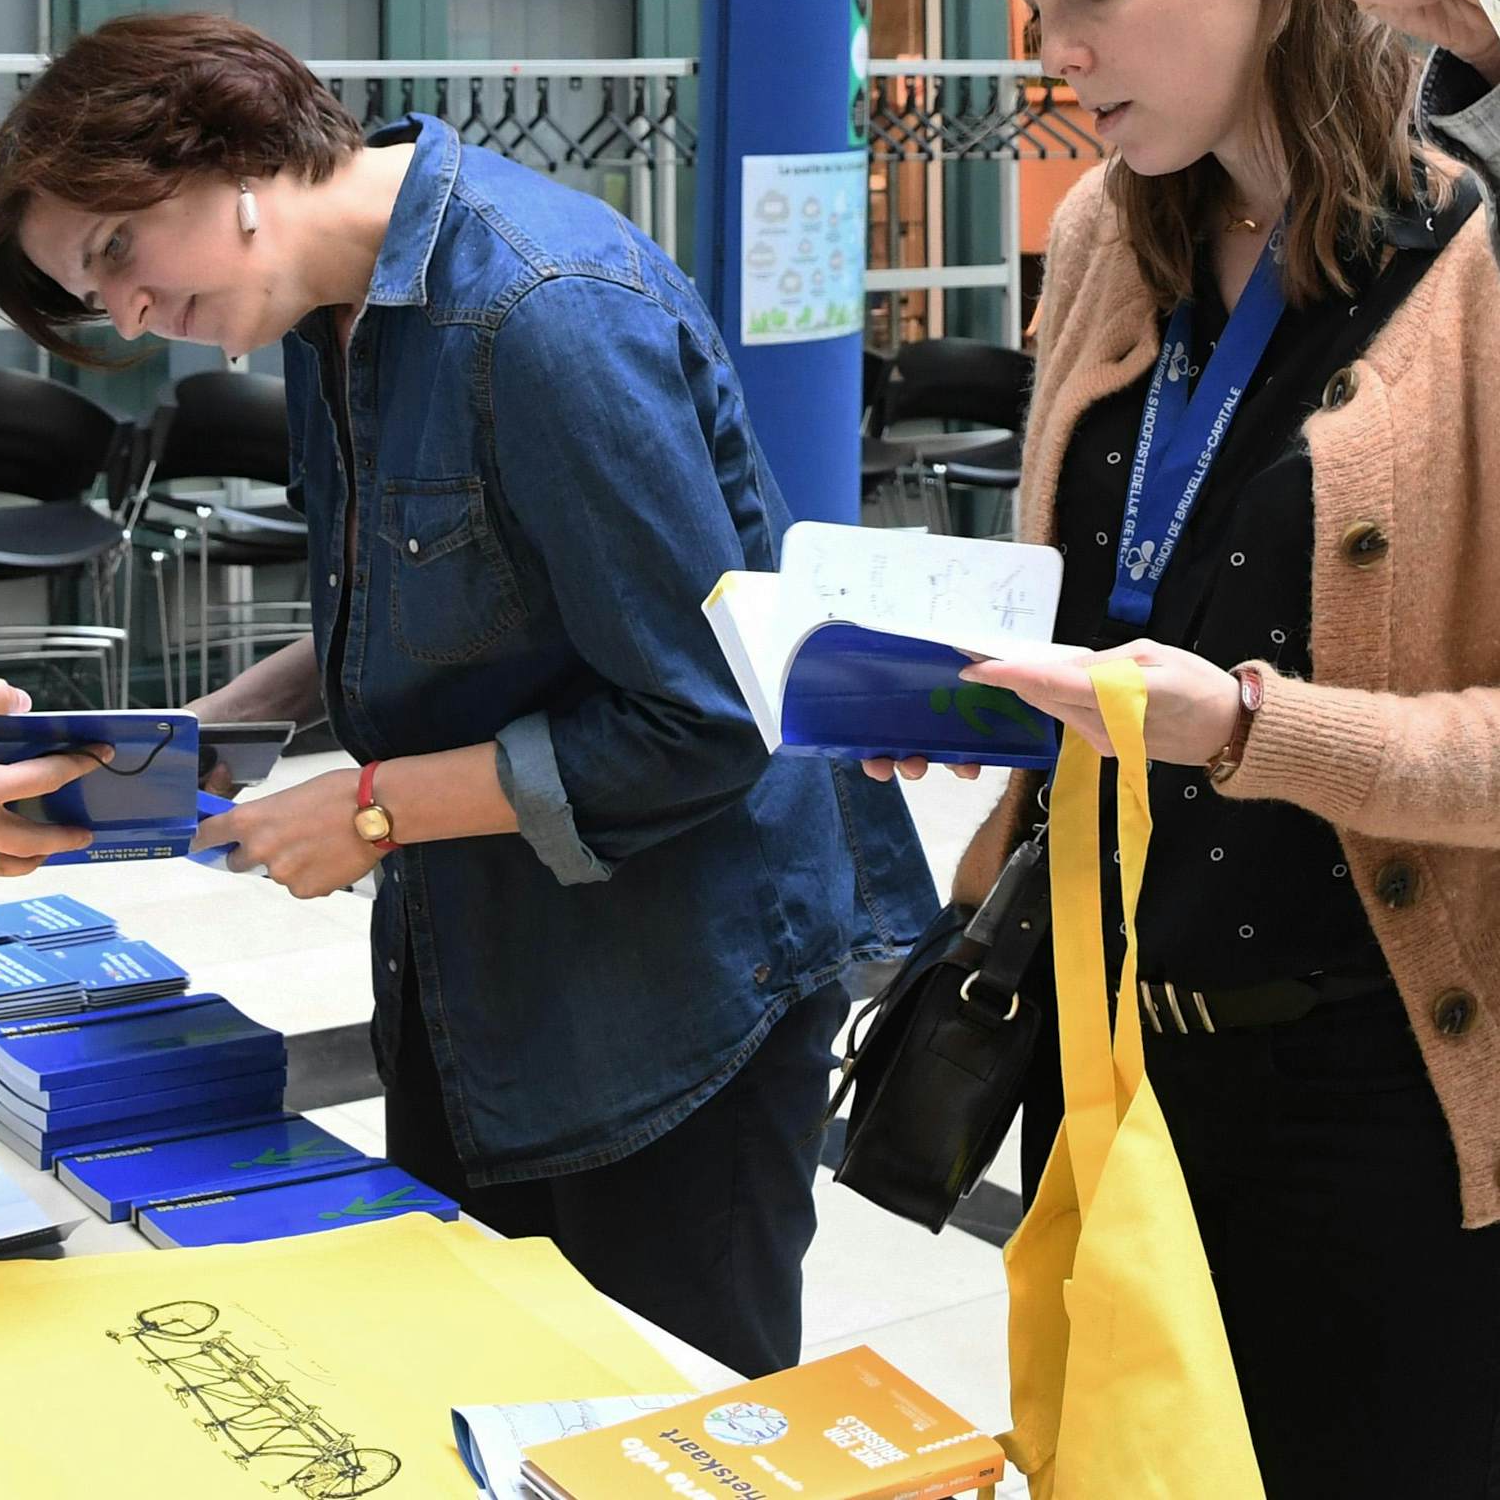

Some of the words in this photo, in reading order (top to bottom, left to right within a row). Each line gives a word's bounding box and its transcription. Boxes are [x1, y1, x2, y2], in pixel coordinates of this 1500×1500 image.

[1147, 342, 1172, 406] BRUSSELS
[1126, 403, 1158, 518] HOOFDSTEDELIJK
[1174, 385, 1242, 522] BRUXELLES-CAPITALE
[1167, 519, 1182, 539] DE
[1148, 537, 1176, 581] RÉGION
[836, 1415, 910, 1462] BRUSSELS
